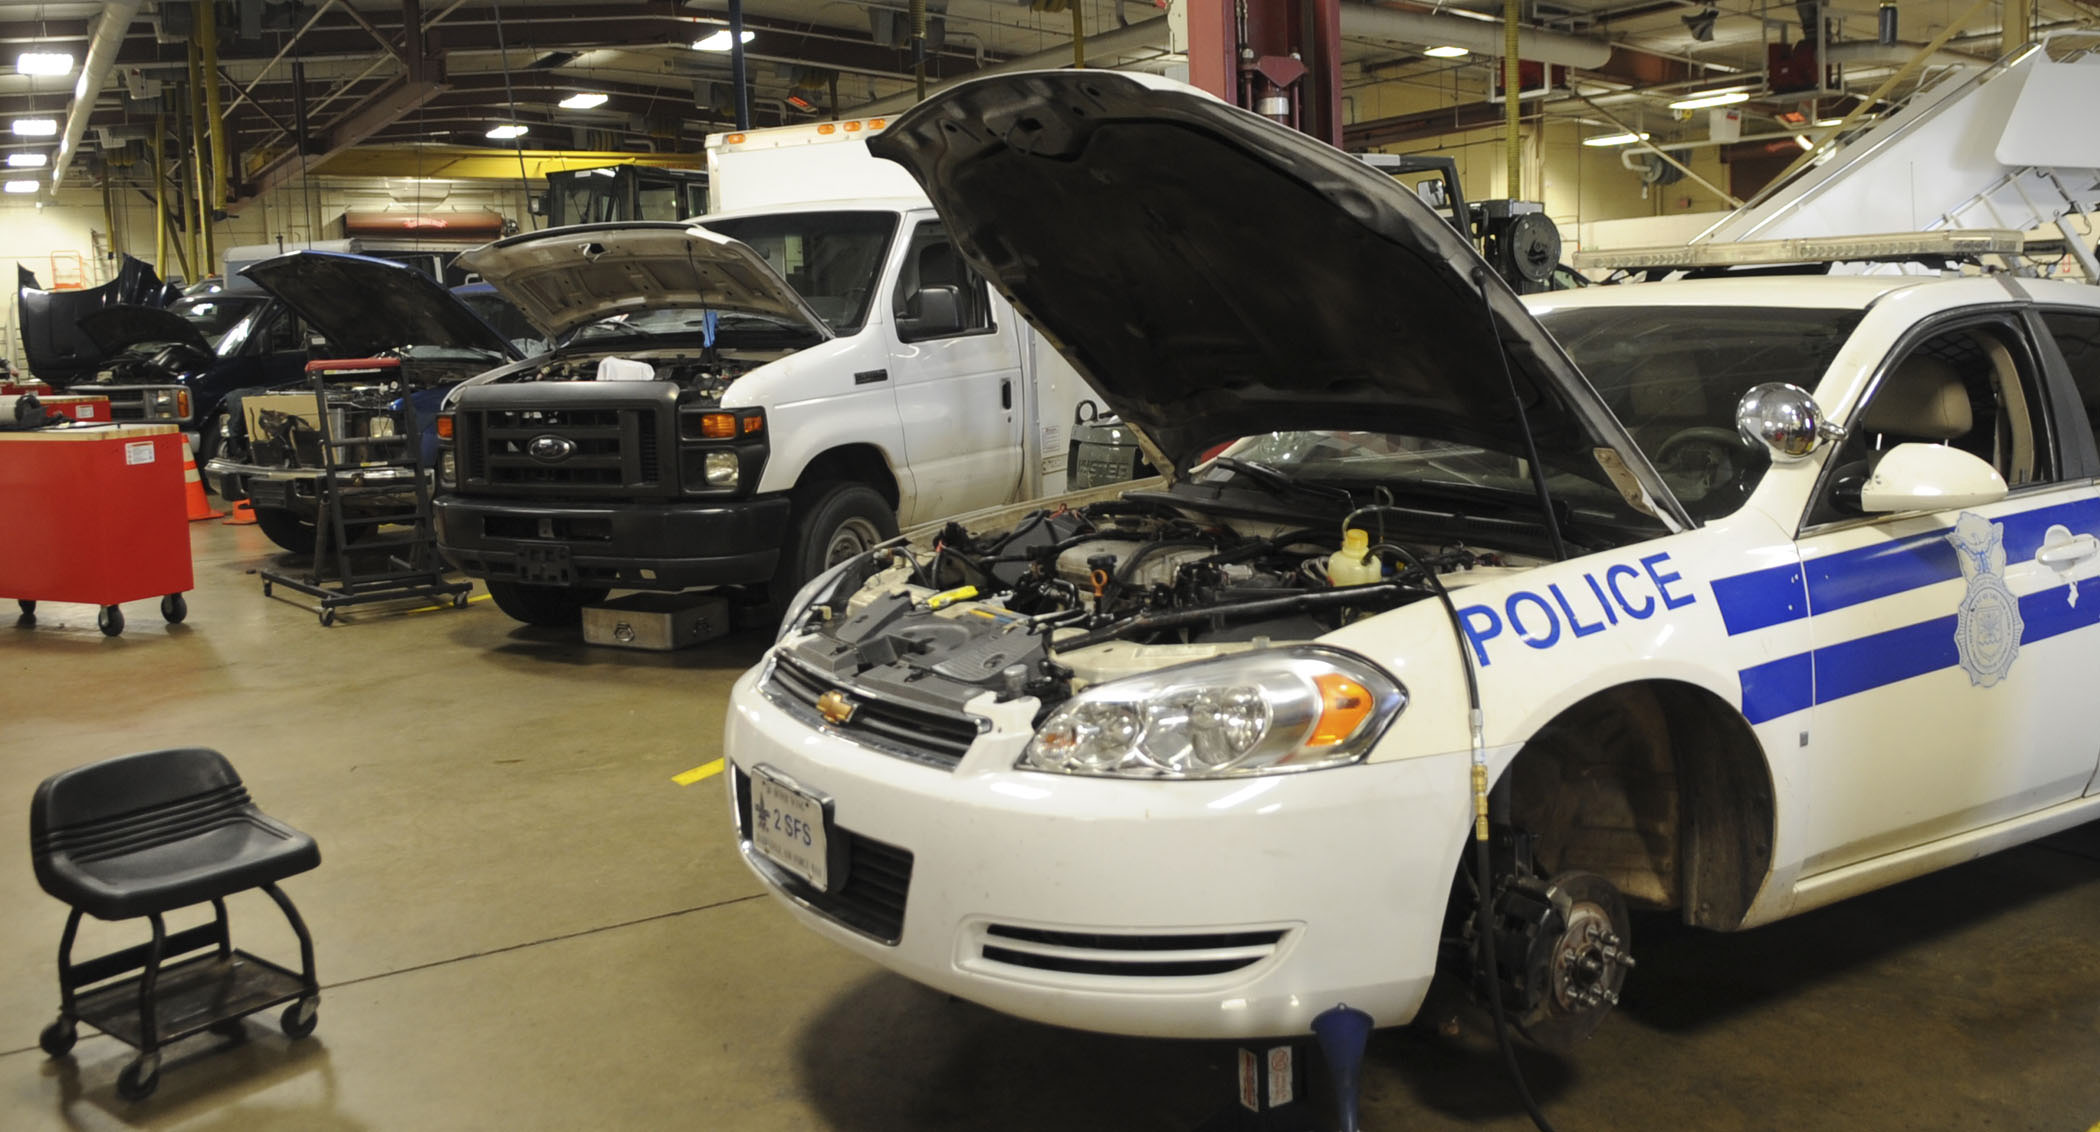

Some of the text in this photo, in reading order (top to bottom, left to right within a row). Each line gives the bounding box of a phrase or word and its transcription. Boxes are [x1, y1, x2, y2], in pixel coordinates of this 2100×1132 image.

[1457, 551, 1697, 668] POLICE
[774, 808, 812, 846] 2 SFS
